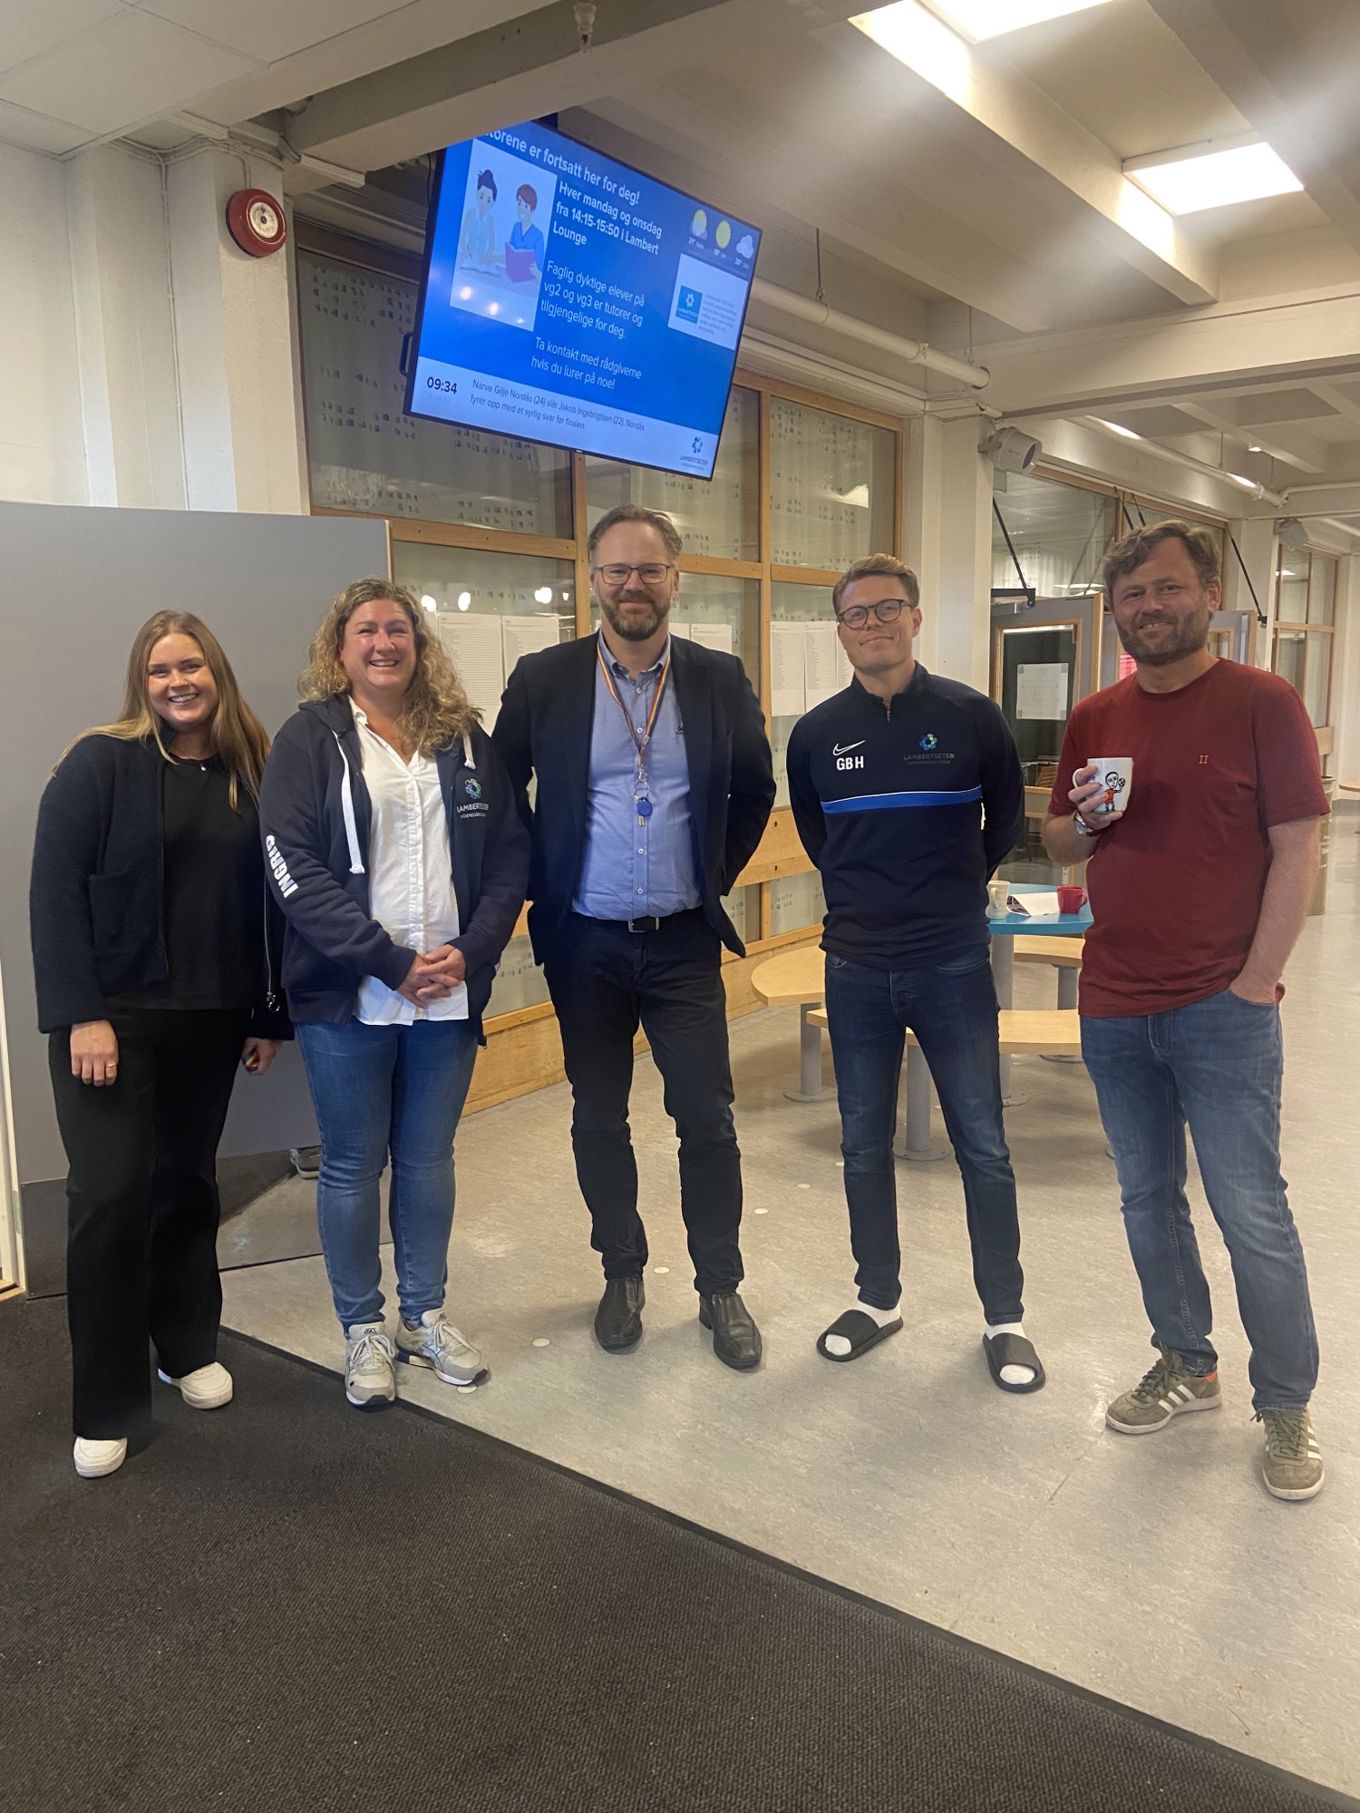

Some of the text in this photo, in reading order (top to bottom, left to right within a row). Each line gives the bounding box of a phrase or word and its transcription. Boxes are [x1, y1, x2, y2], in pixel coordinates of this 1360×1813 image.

[486, 130, 640, 206] torene er fortsatt her for deg!
[556, 202, 569, 218] fra
[571, 207, 620, 238] 14:15-15:50
[625, 231, 659, 255] Lambert
[559, 180, 662, 239] Hver mandag og onsdag
[552, 221, 588, 246] Lounge
[543, 282, 643, 328] vg2 og vg3 er tutorer og
[546, 260, 645, 307] Faglig dyktige elever på
[540, 299, 626, 340] tilgjengelige for deg.
[531, 355, 549, 371] hvis
[550, 362, 562, 375] du
[564, 363, 584, 380] lurer
[584, 371, 596, 385] på
[535, 336, 642, 380] Ta kontakt med rådgiverne
[426, 376, 457, 395] 09:34
[836, 755, 864, 771] GBH
[266, 834, 299, 898] INGRID
